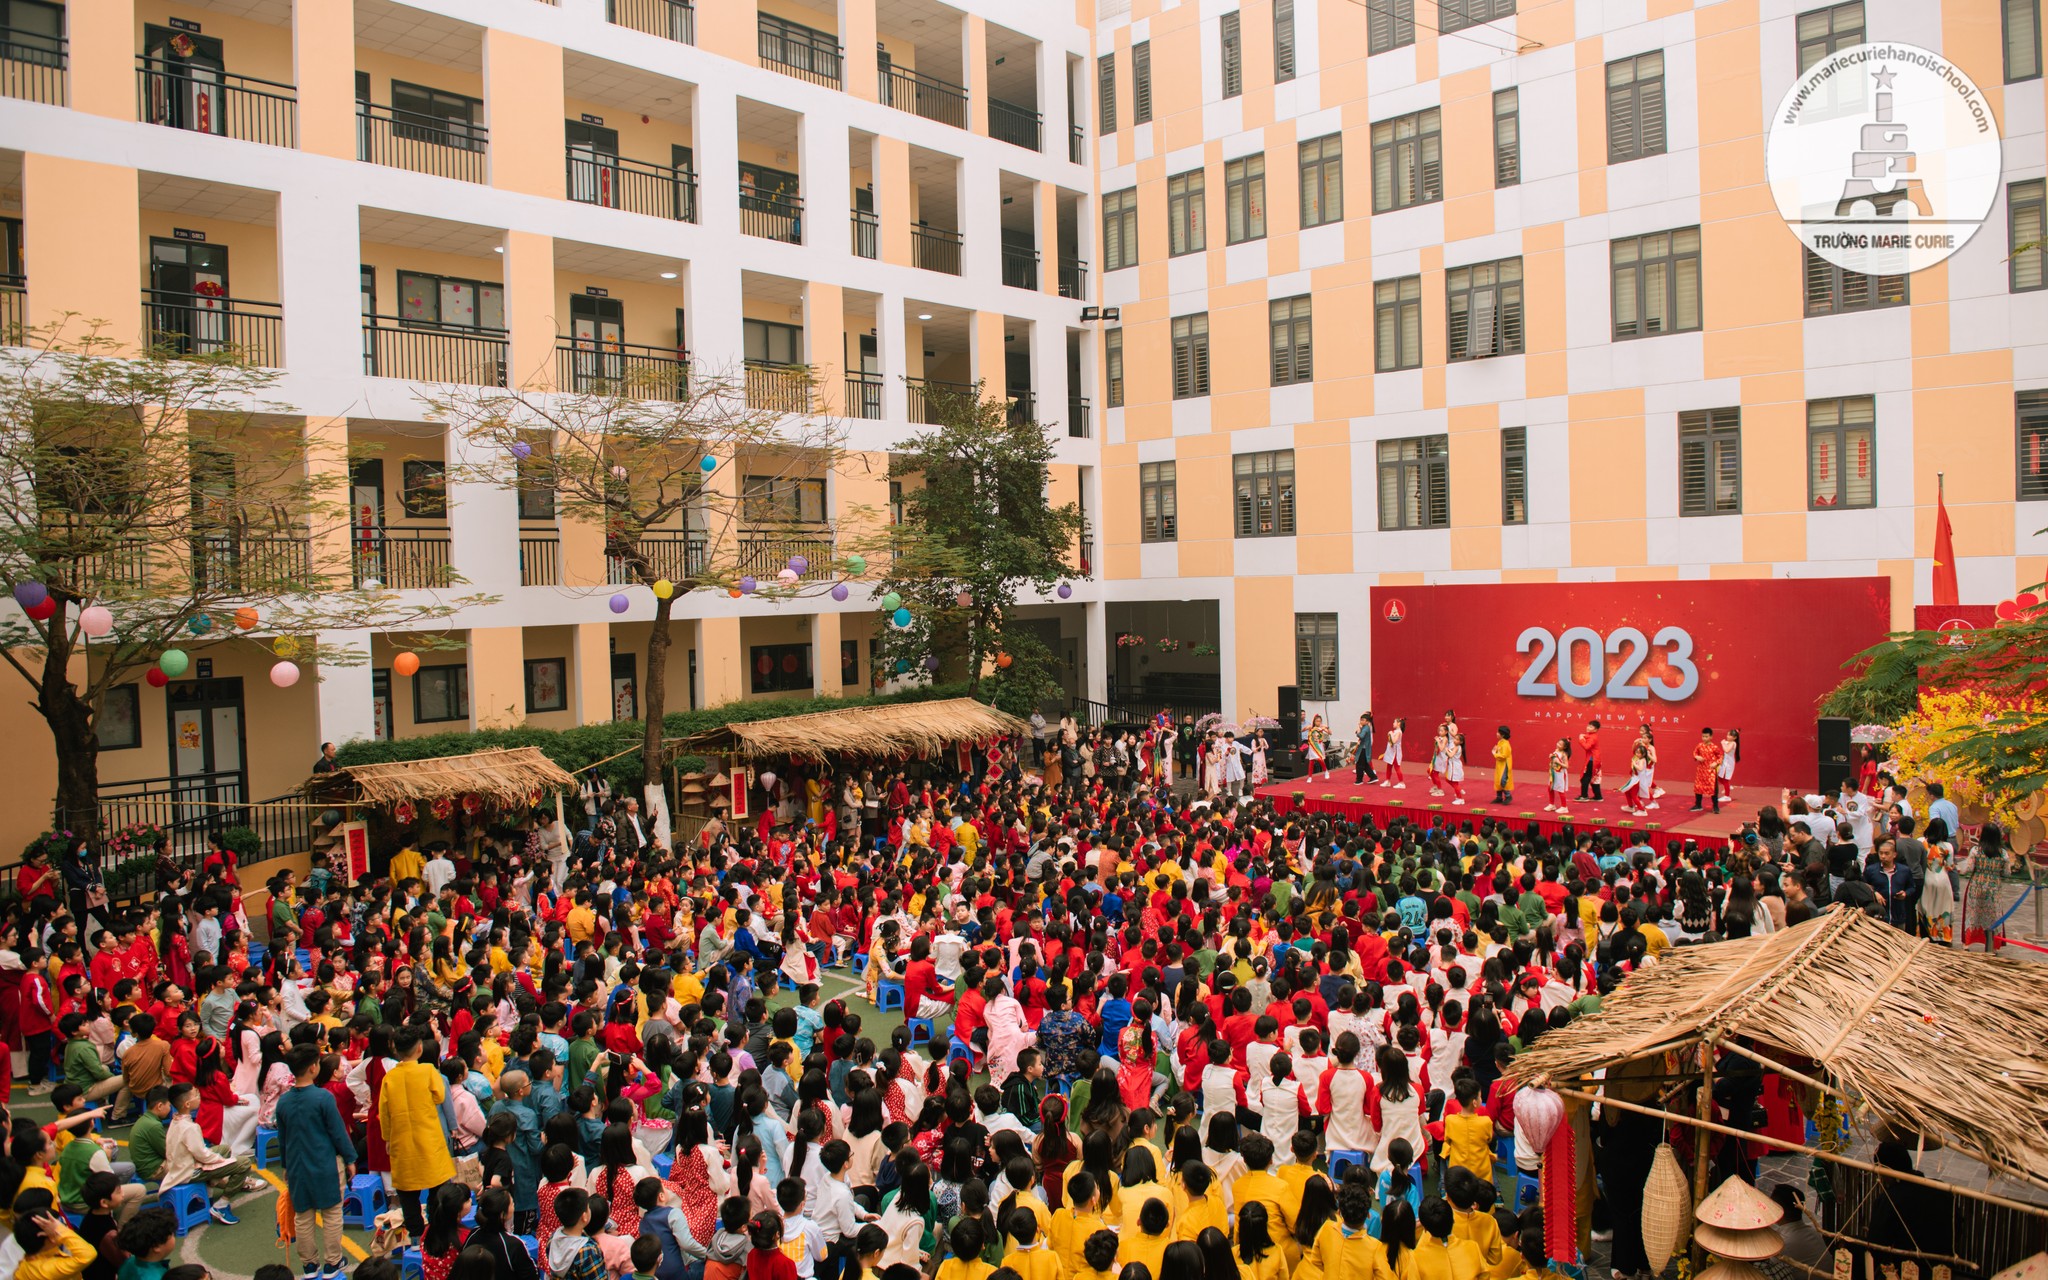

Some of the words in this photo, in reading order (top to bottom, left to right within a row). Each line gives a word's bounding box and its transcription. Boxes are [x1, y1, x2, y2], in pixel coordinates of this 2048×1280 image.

[1516, 626, 1699, 701] 2023
[1534, 711, 1582, 719] HAPPY
[1595, 713, 1625, 721] NEW
[1639, 715, 1679, 724] YEAR
